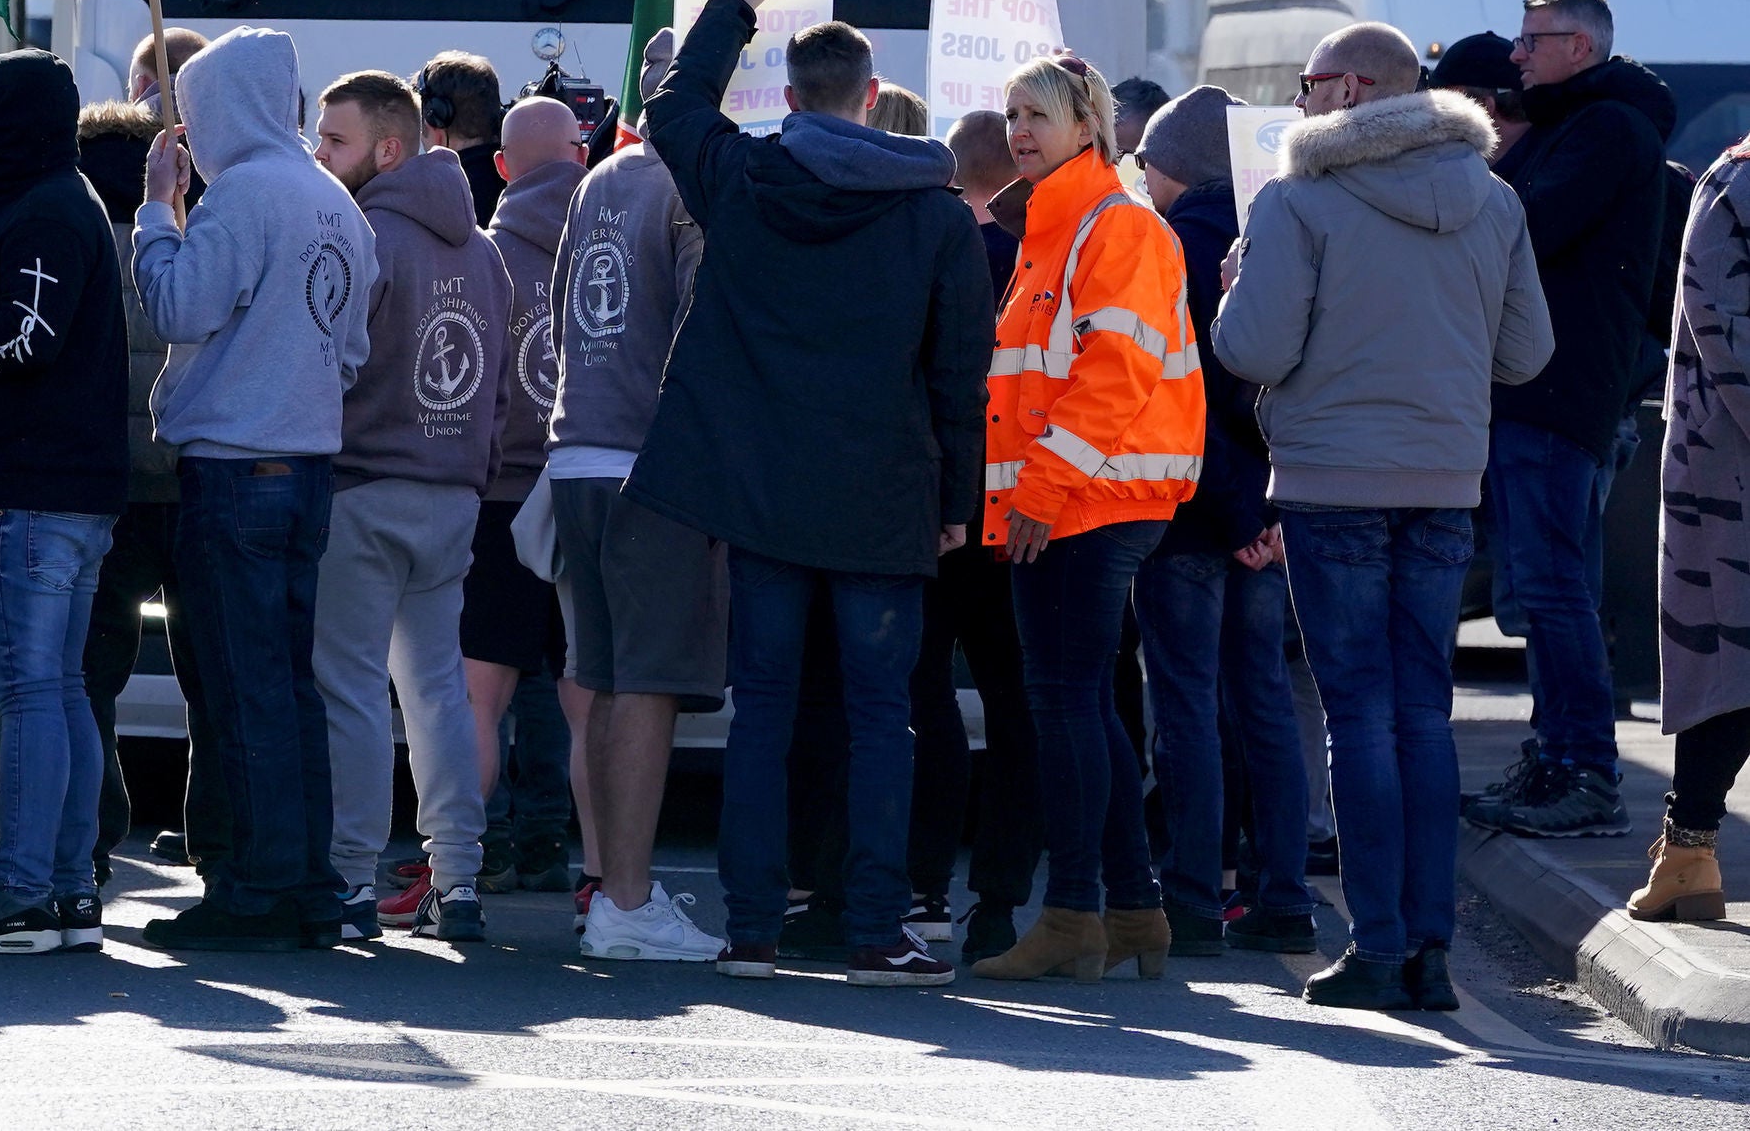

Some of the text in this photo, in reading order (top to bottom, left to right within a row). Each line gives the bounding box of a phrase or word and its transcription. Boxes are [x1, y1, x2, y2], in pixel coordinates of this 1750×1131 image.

[316, 210, 342, 228] RMT
[597, 205, 628, 227] RMT
[432, 276, 465, 296] RMT
[415, 297, 489, 338] DOVER SHIPPING
[512, 302, 549, 337] DOVER
[417, 412, 472, 424] MARITIME
[424, 424, 462, 439] UNION
